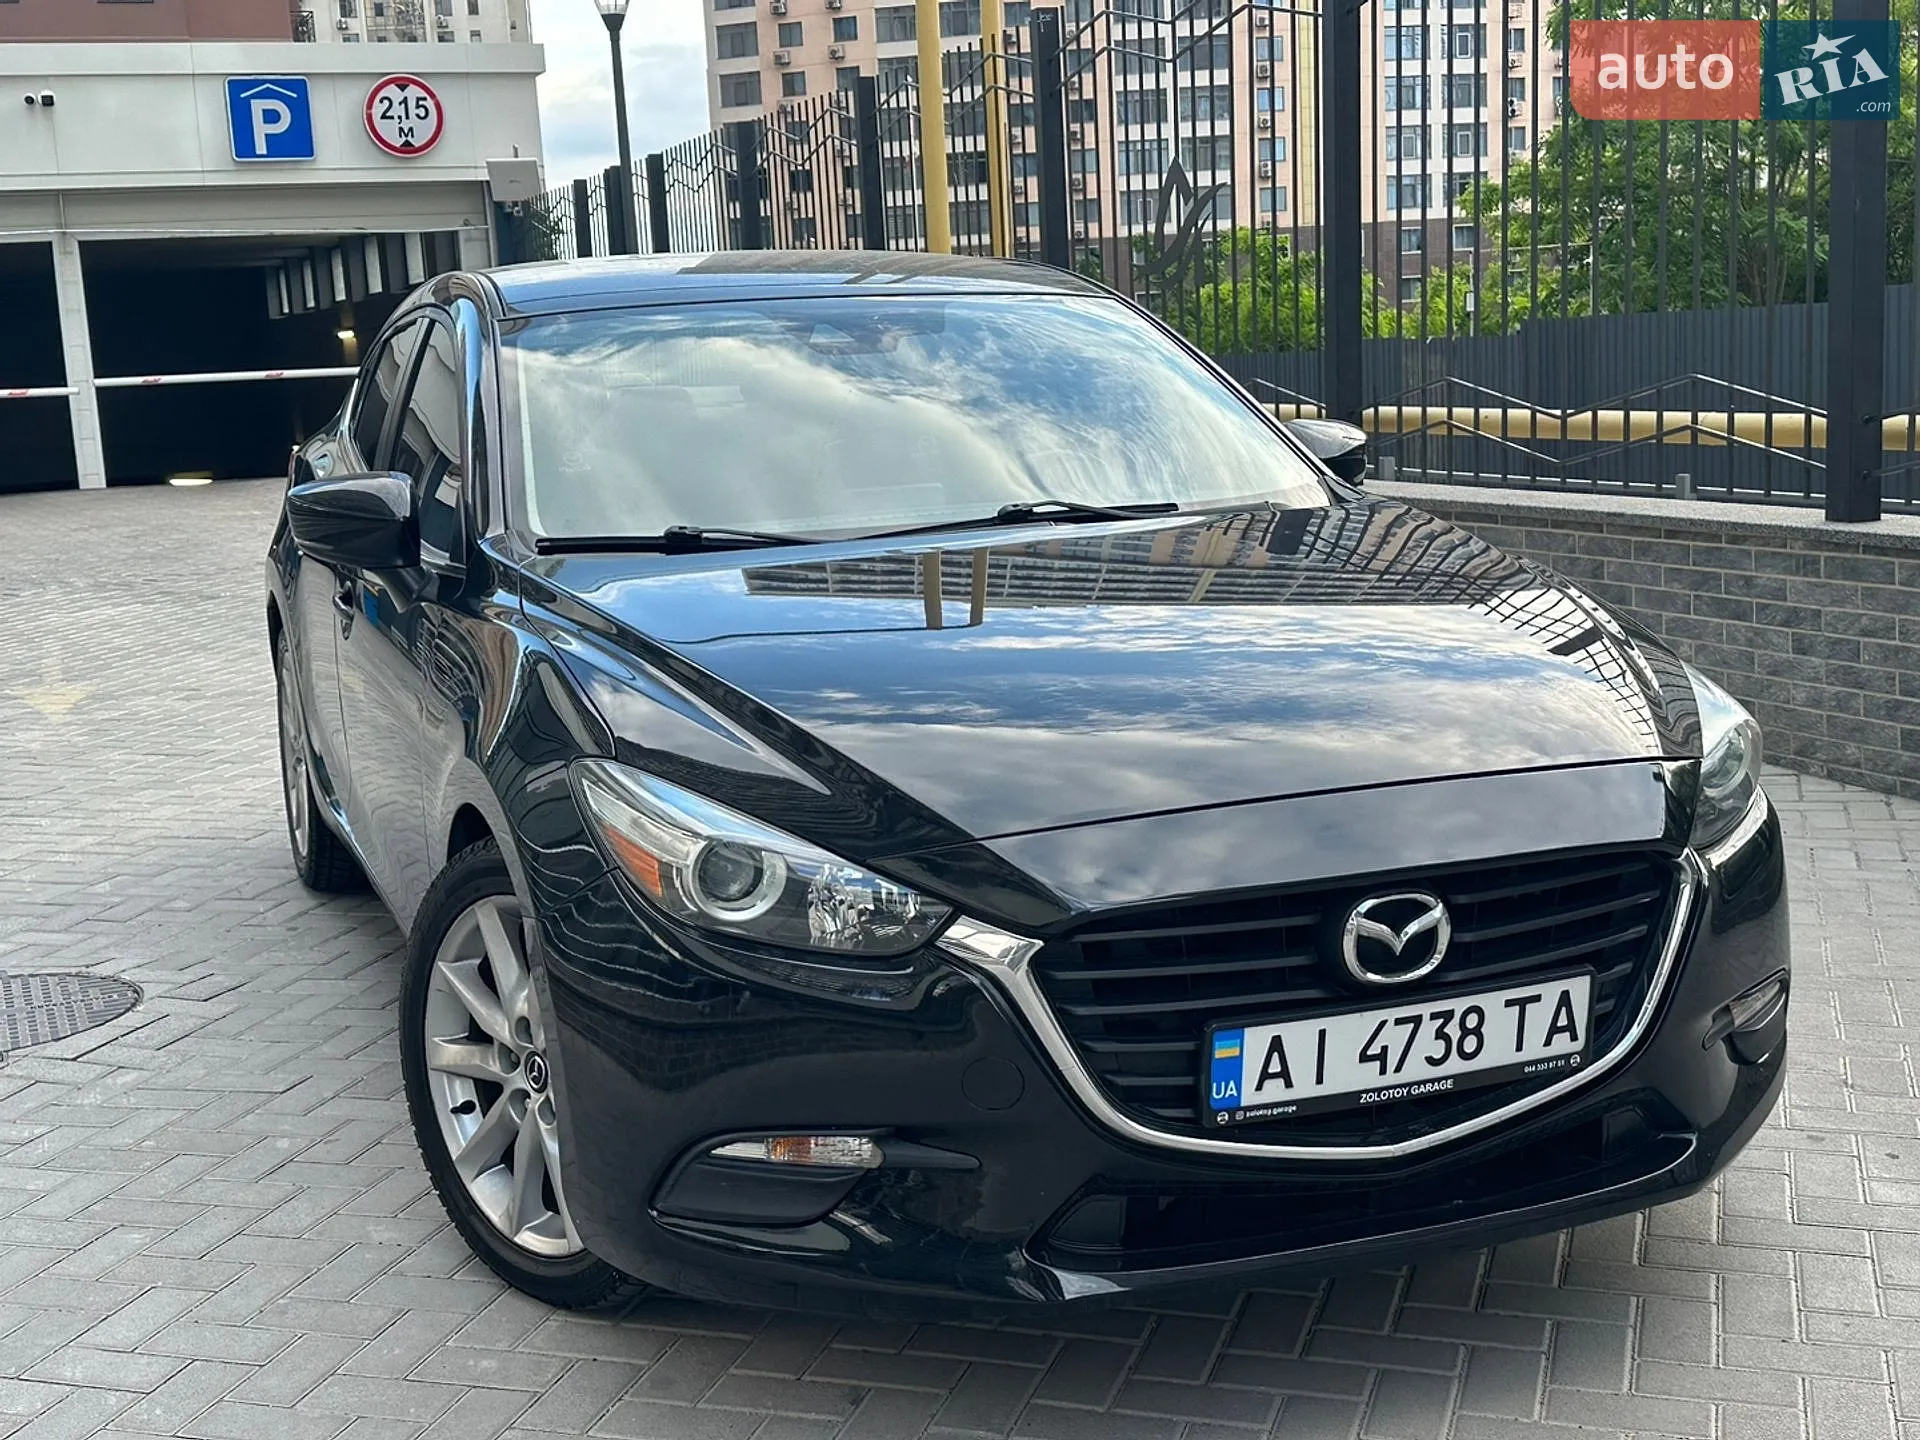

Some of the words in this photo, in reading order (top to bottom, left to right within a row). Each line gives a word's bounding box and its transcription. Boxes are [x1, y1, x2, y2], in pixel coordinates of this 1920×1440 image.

[378, 95, 430, 124] 2,15
[250, 98, 291, 155] P
[1358, 1004, 1485, 1077] 4738
[1504, 989, 1579, 1053] TA
[1212, 1081, 1238, 1099] UA
[1359, 1088, 1409, 1103] ZOLOTOY
[1411, 1078, 1453, 1095] GARAGE
